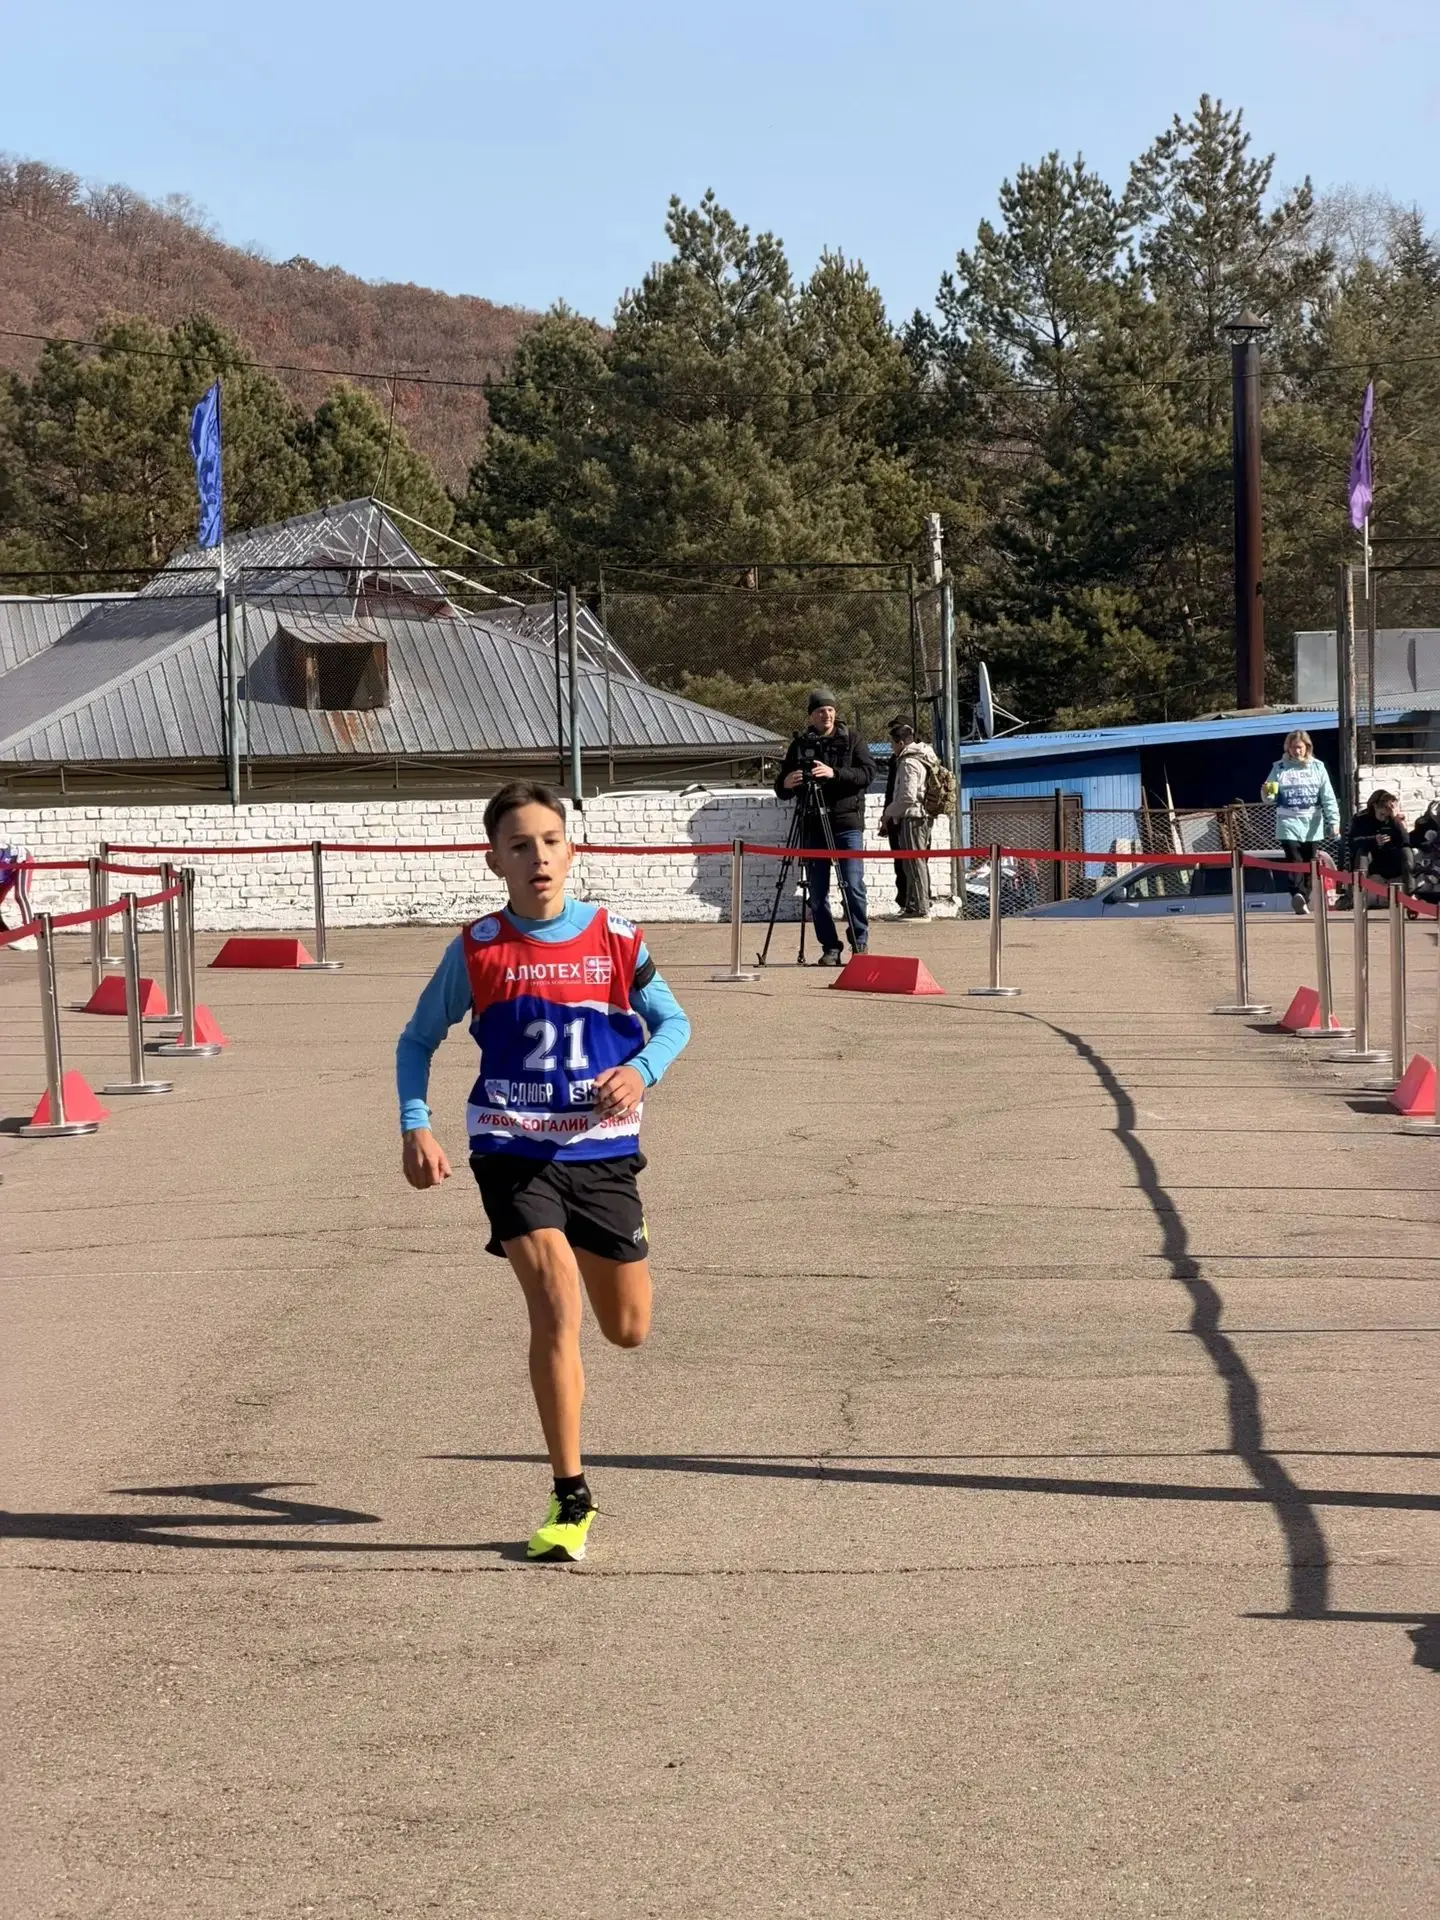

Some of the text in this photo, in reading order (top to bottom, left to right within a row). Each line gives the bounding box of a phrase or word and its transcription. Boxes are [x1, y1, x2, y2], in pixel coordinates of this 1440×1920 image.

[505, 963, 580, 982] АЛЮТЕХ
[523, 1018, 589, 1071] 21
[522, 1115, 589, 1133] БОГАЛИЙ
